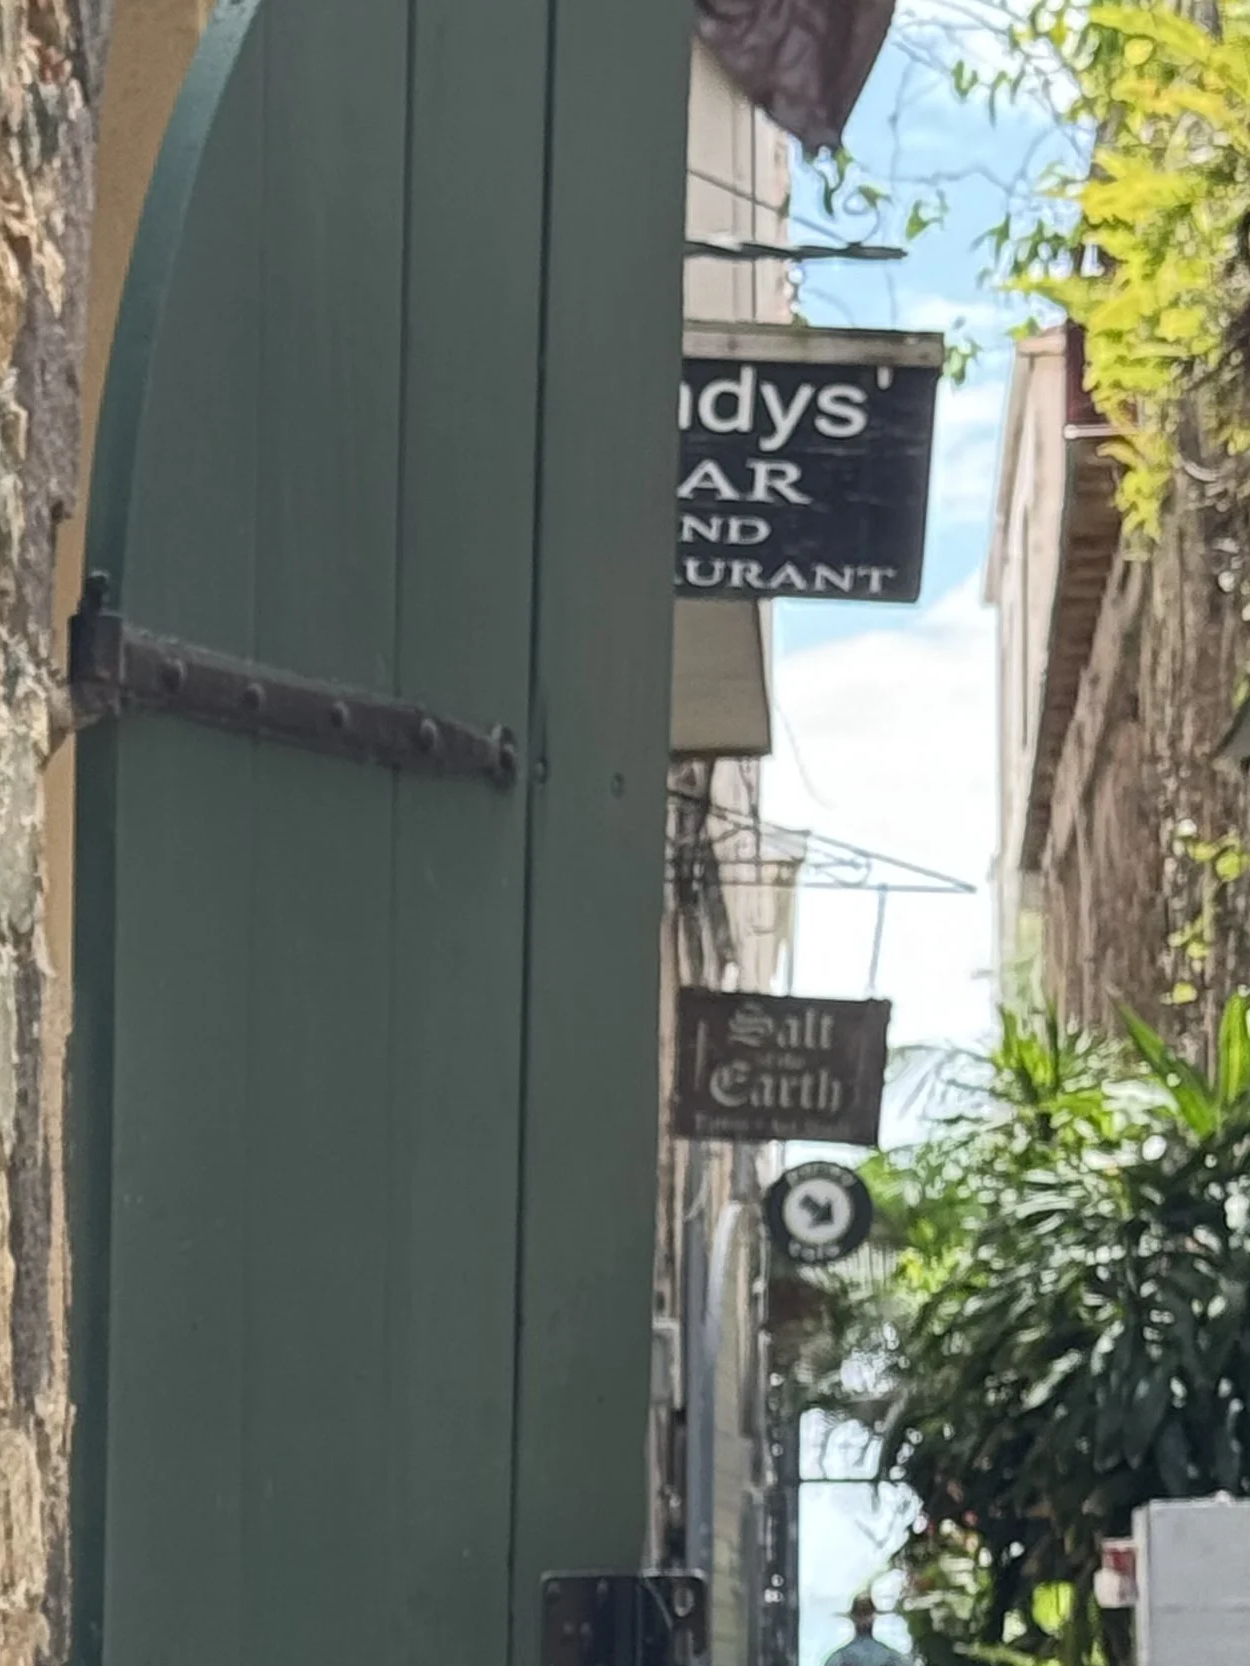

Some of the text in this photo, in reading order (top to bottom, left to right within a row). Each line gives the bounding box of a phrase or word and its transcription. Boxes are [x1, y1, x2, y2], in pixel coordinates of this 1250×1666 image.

[678, 366, 892, 452] dys'
[676, 458, 812, 505] AR
[680, 516, 772, 545] ND
[675, 557, 895, 593] URANT
